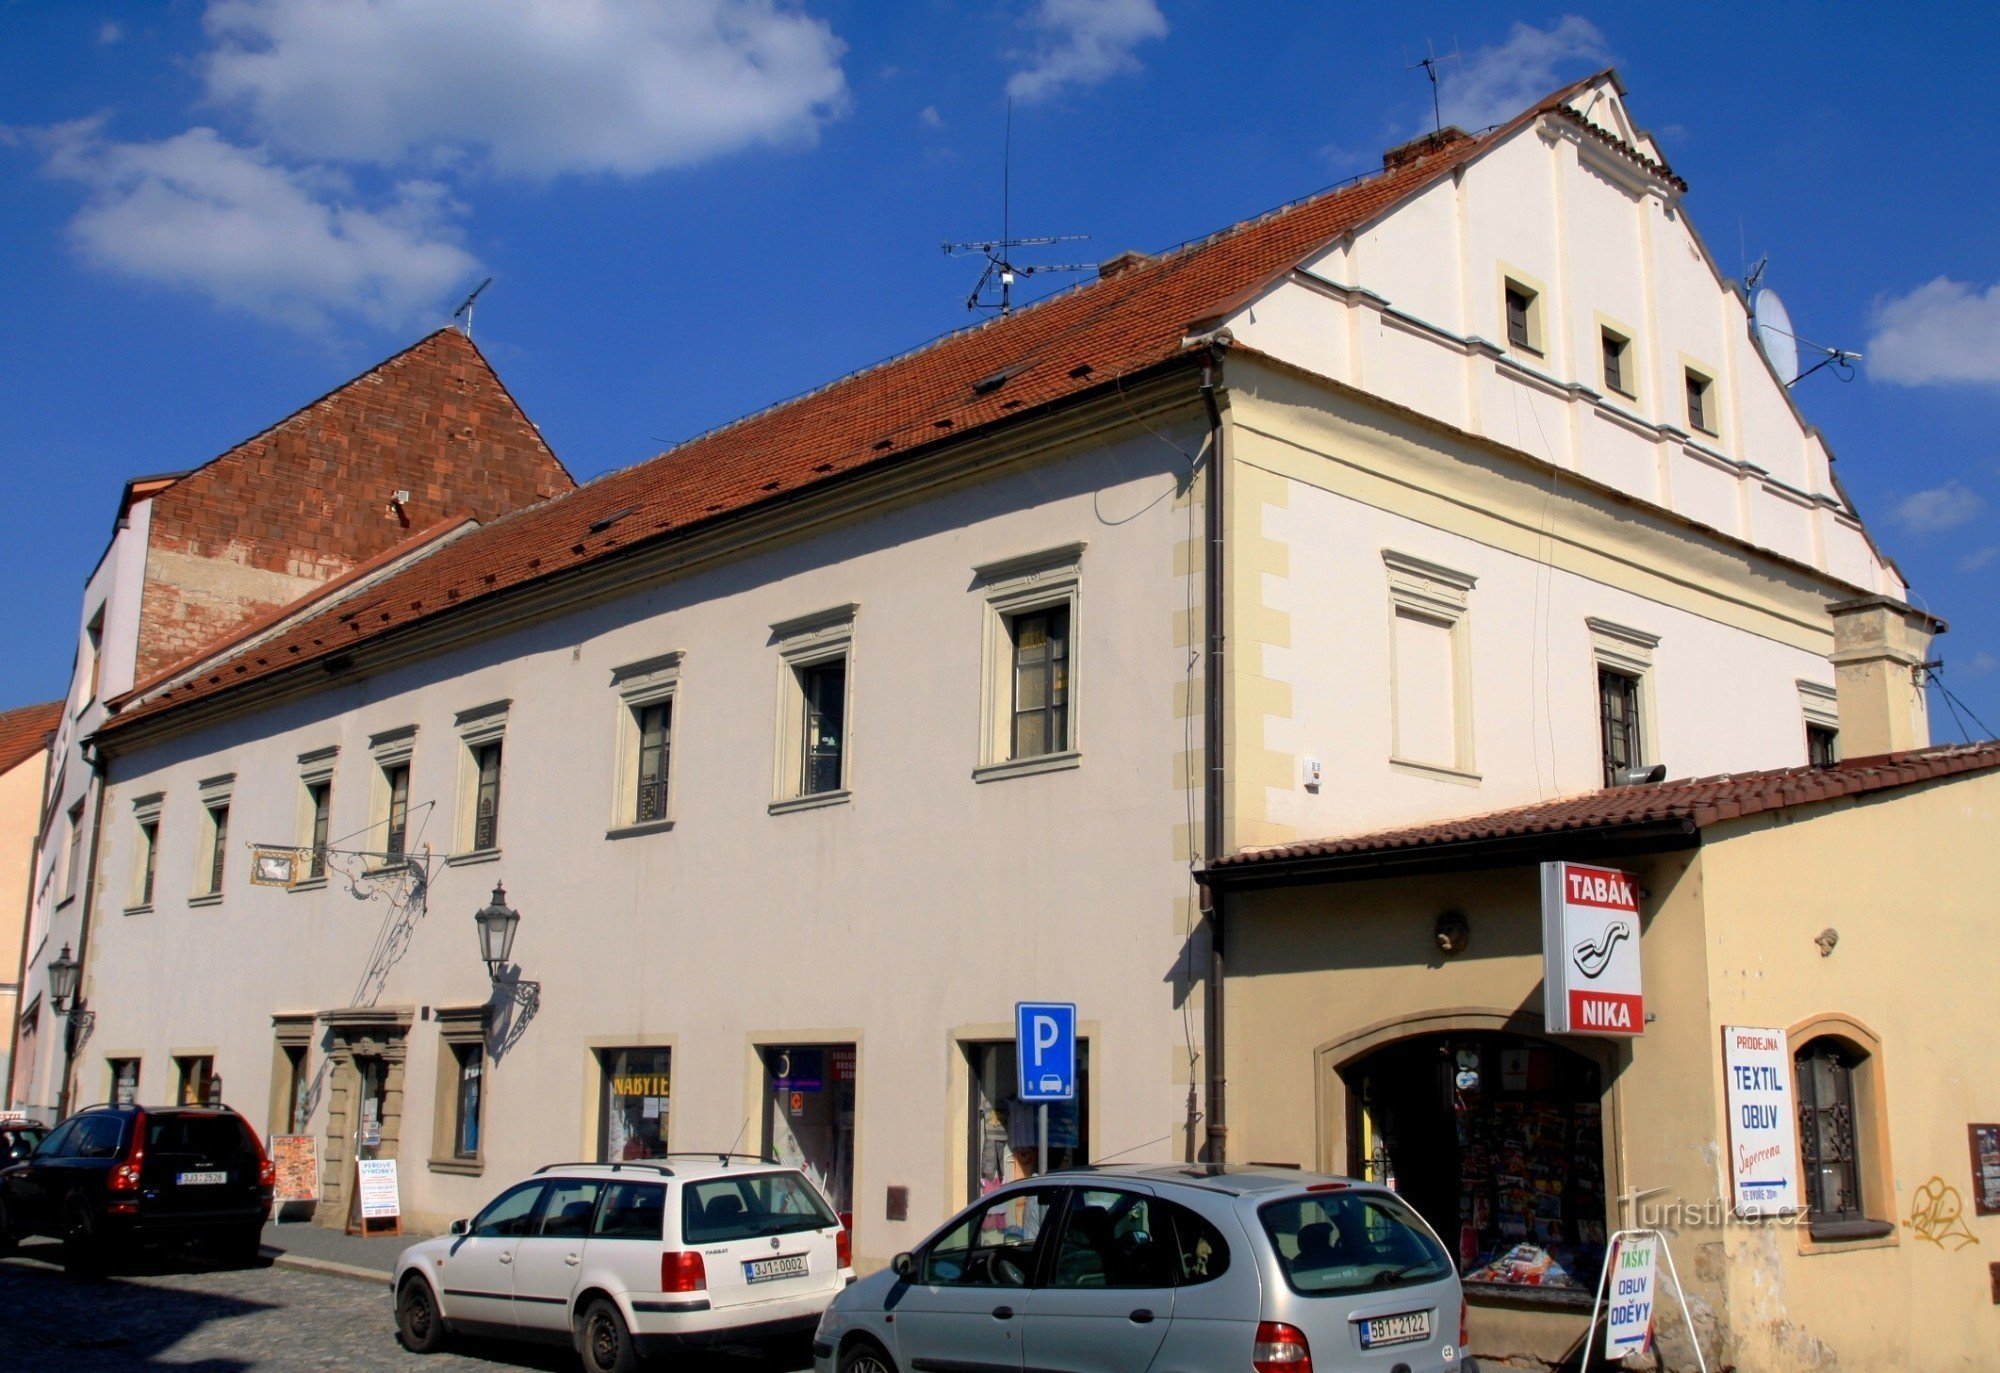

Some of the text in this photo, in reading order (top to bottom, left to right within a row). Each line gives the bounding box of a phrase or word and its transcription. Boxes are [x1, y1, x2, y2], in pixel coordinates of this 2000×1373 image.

[1569, 873, 1634, 906] TABÁK
[1582, 1000, 1631, 1028] NIKA
[1033, 1015, 1059, 1067] P
[1736, 1035, 1779, 1051] PRODEJNA
[614, 1073, 669, 1096] NÁBYTE
[1733, 1065, 1783, 1091] TEXTIL
[1741, 1104, 1778, 1129] OBUV
[1738, 1144, 1781, 1175] Supercena
[755, 1257, 804, 1275] 3J1 0002
[1618, 1277, 1647, 1296] OBUV
[1611, 1298, 1650, 1326] ODĚVY
[1371, 1315, 1425, 1338] 5B1 2122
